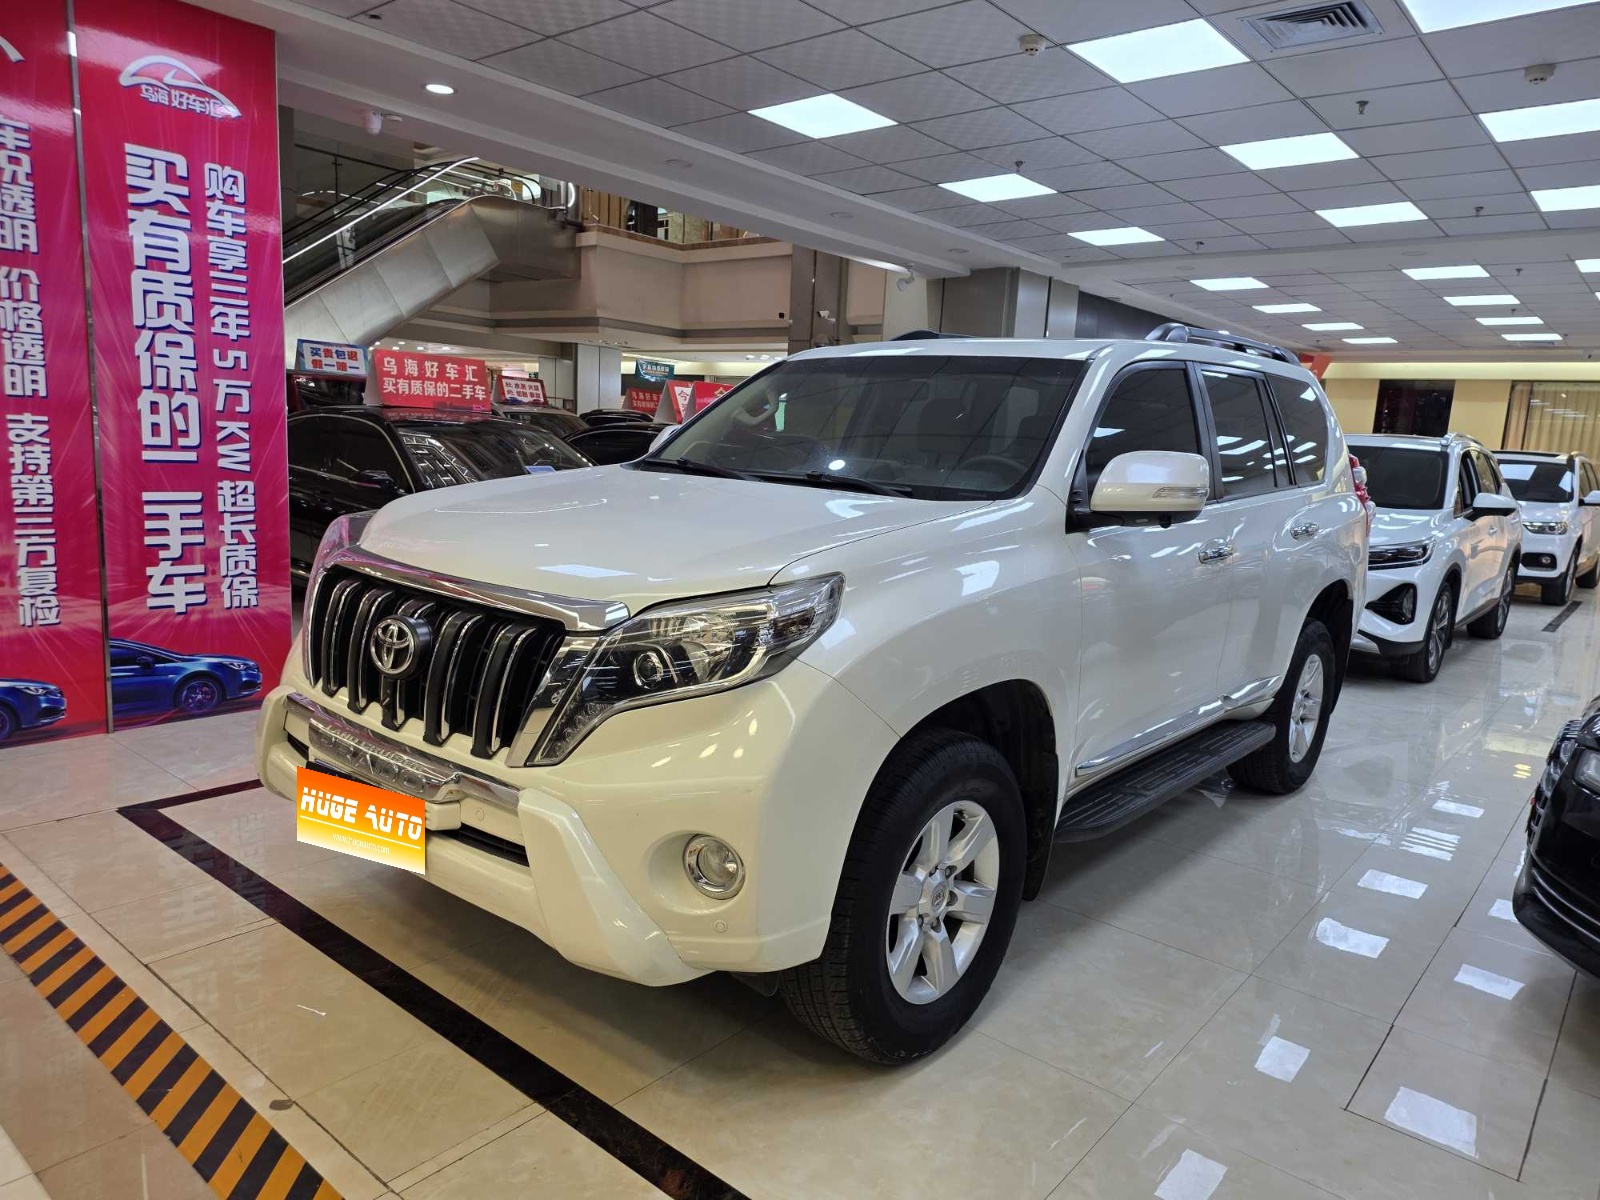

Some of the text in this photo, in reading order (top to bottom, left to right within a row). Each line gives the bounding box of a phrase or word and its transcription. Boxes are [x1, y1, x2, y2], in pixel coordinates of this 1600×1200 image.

[124, 142, 208, 614] 买有质保的二手车
[383, 357, 478, 381] 乌海好车汇
[383, 377, 486, 400] 买有质保的二手车
[5, 413, 61, 626] 支持第三方复检
